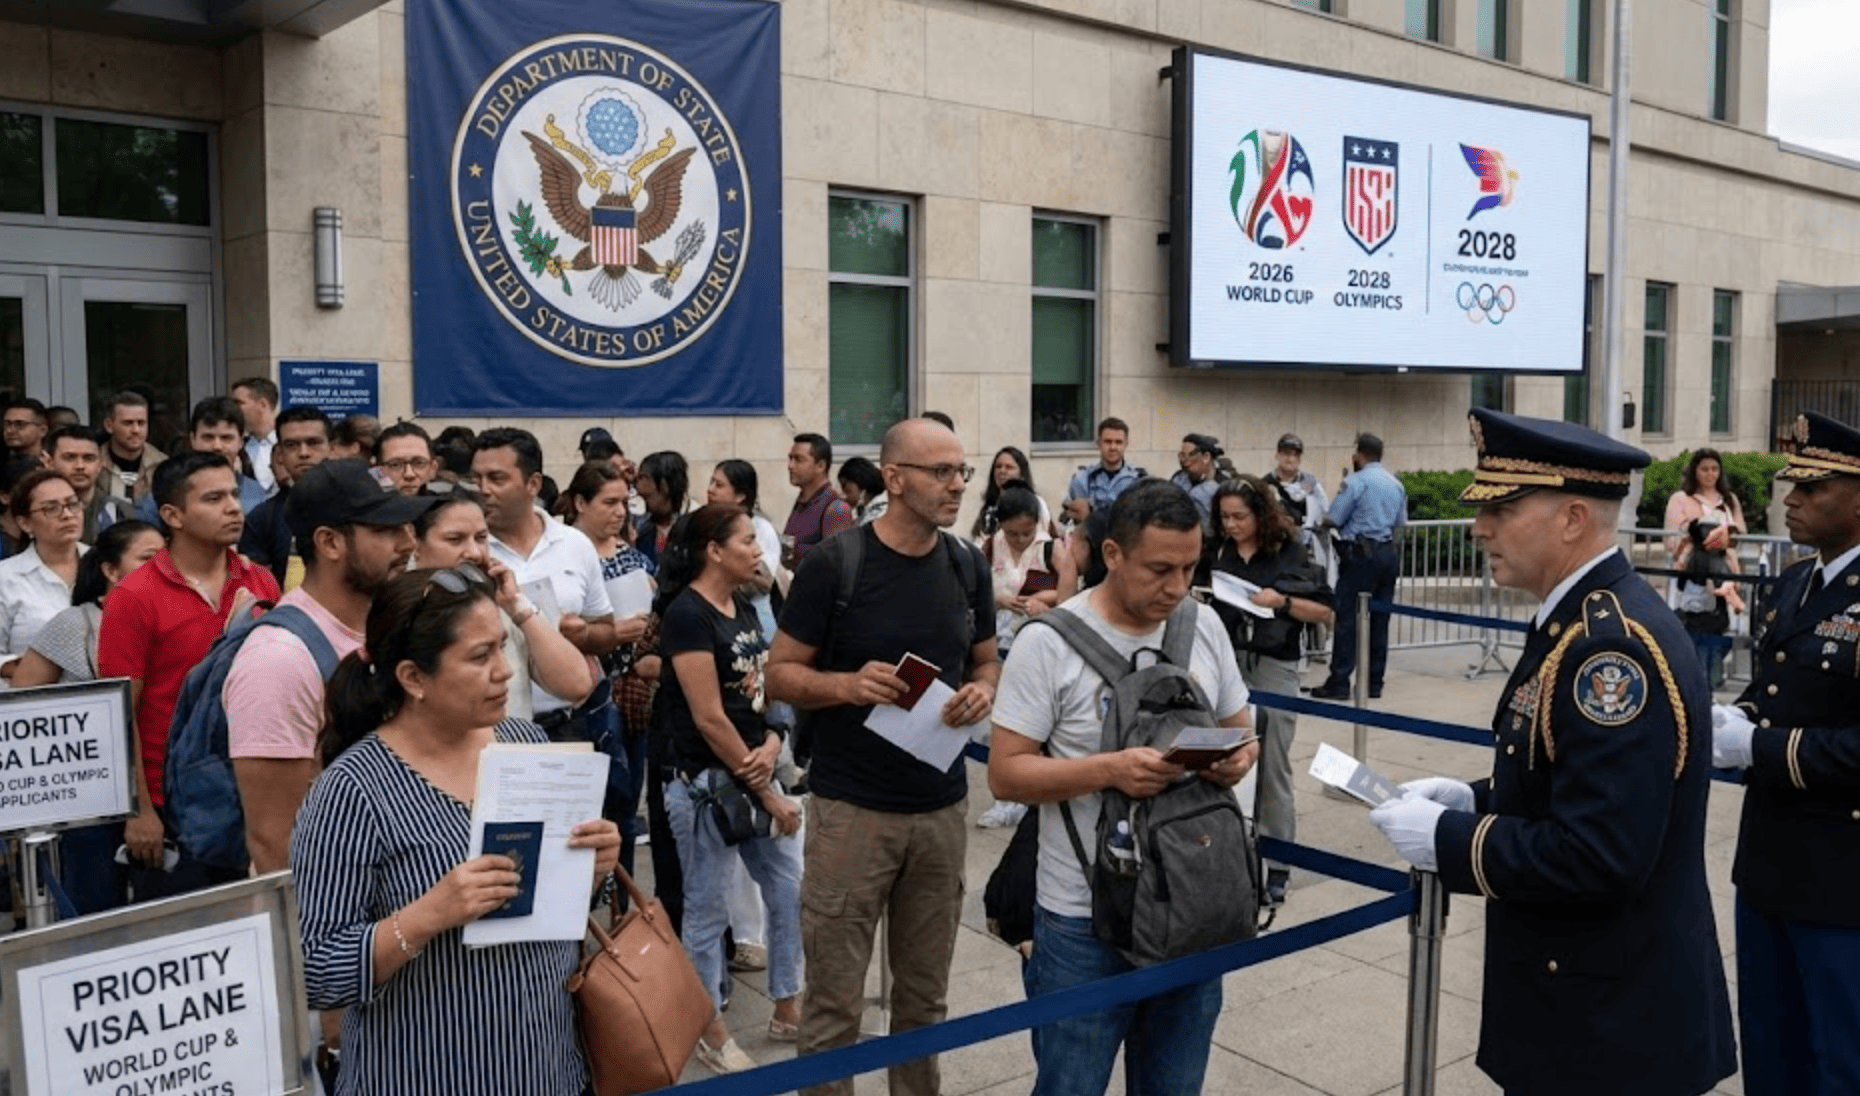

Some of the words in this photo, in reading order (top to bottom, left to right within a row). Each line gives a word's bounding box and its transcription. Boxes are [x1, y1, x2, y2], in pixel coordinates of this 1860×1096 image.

[476, 47, 635, 140] DEPARTMENT
[639, 61, 675, 92] OF
[673, 87, 731, 167] STATE
[1457, 228, 1516, 261] 2028
[467, 199, 532, 311] UNITED
[531, 307, 626, 355] STATES
[633, 327, 667, 352] OF
[673, 226, 741, 333] AMERICA
[1249, 261, 1293, 283] 2026
[1347, 269, 1391, 290] 2028
[1226, 284, 1282, 303] WORLD
[1284, 288, 1314, 304] CUP
[1333, 291, 1403, 311] OLYMPICS
[0, 711, 90, 742] IORITY
[30, 738, 99, 767] LANE
[7, 776, 36, 791] CUP
[39, 775, 49, 787] &
[52, 767, 109, 785] OLYMPIC
[0, 787, 77, 809] PPLICANTS
[73, 946, 232, 1012] PRIORITY
[65, 1008, 149, 1054] VISA
[157, 982, 247, 1032] LANE
[83, 1047, 168, 1086] WORLD
[173, 1033, 218, 1061] CUP
[224, 1027, 239, 1048] &
[115, 1061, 213, 1096] OLYMPIC
